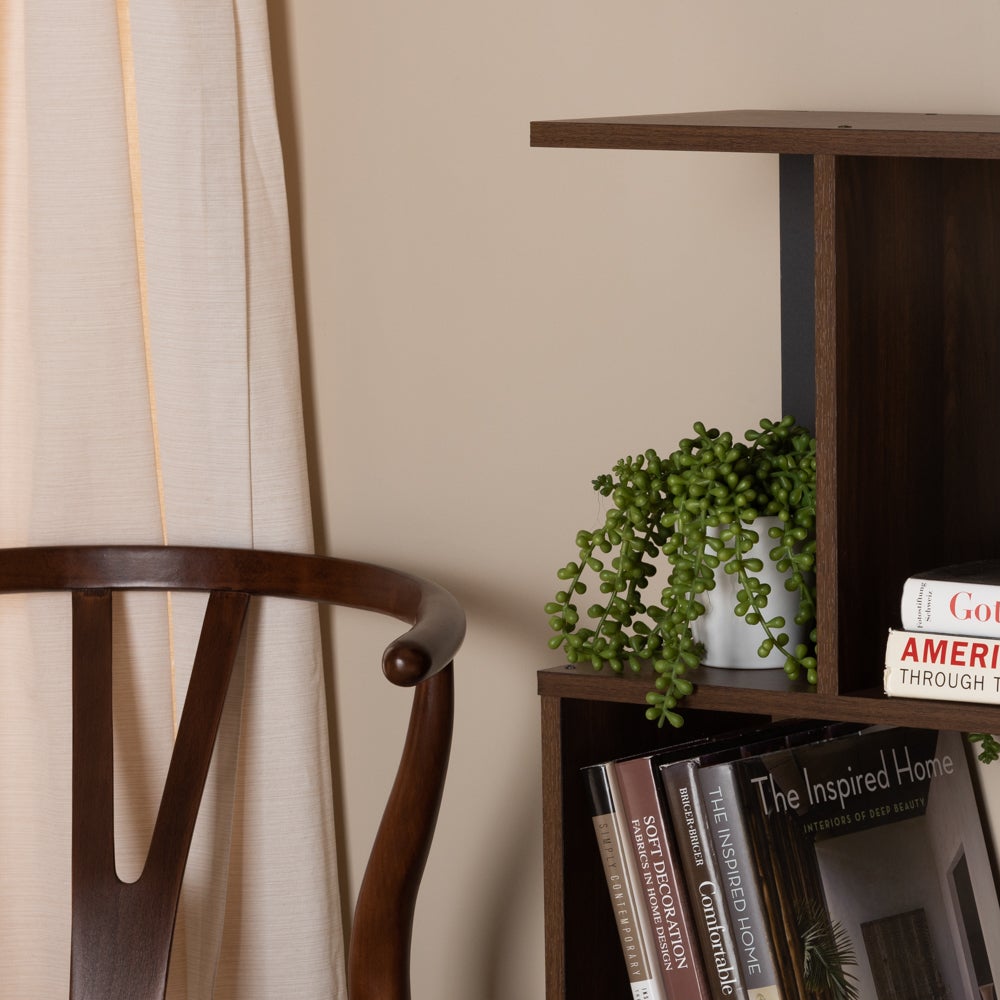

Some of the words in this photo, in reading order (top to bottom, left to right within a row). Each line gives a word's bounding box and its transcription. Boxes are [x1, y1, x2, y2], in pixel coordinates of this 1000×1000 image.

[900, 668, 985, 691] THROUGH
[709, 786, 728, 823] THE
[751, 773, 800, 815] The
[803, 749, 890, 809] Inspired
[892, 746, 954, 785] Home
[803, 814, 852, 833] INTERIORS
[854, 810, 866, 822] OF
[869, 806, 891, 819] DEEP
[894, 798, 926, 813] BEAUTY
[631, 819, 650, 870] FABRICS
[643, 873, 653, 885] IN
[643, 815, 662, 857] SOFT
[653, 860, 688, 969] DECORATION
[717, 828, 746, 913] INSPIRED
[598, 823, 617, 868] SIMPLY
[610, 874, 640, 976] CONTEMPORARY
[647, 888, 663, 924] HOME
[656, 926, 673, 971] DESIGN
[698, 881, 737, 995] Comfortable
[737, 917, 762, 976] HOME
